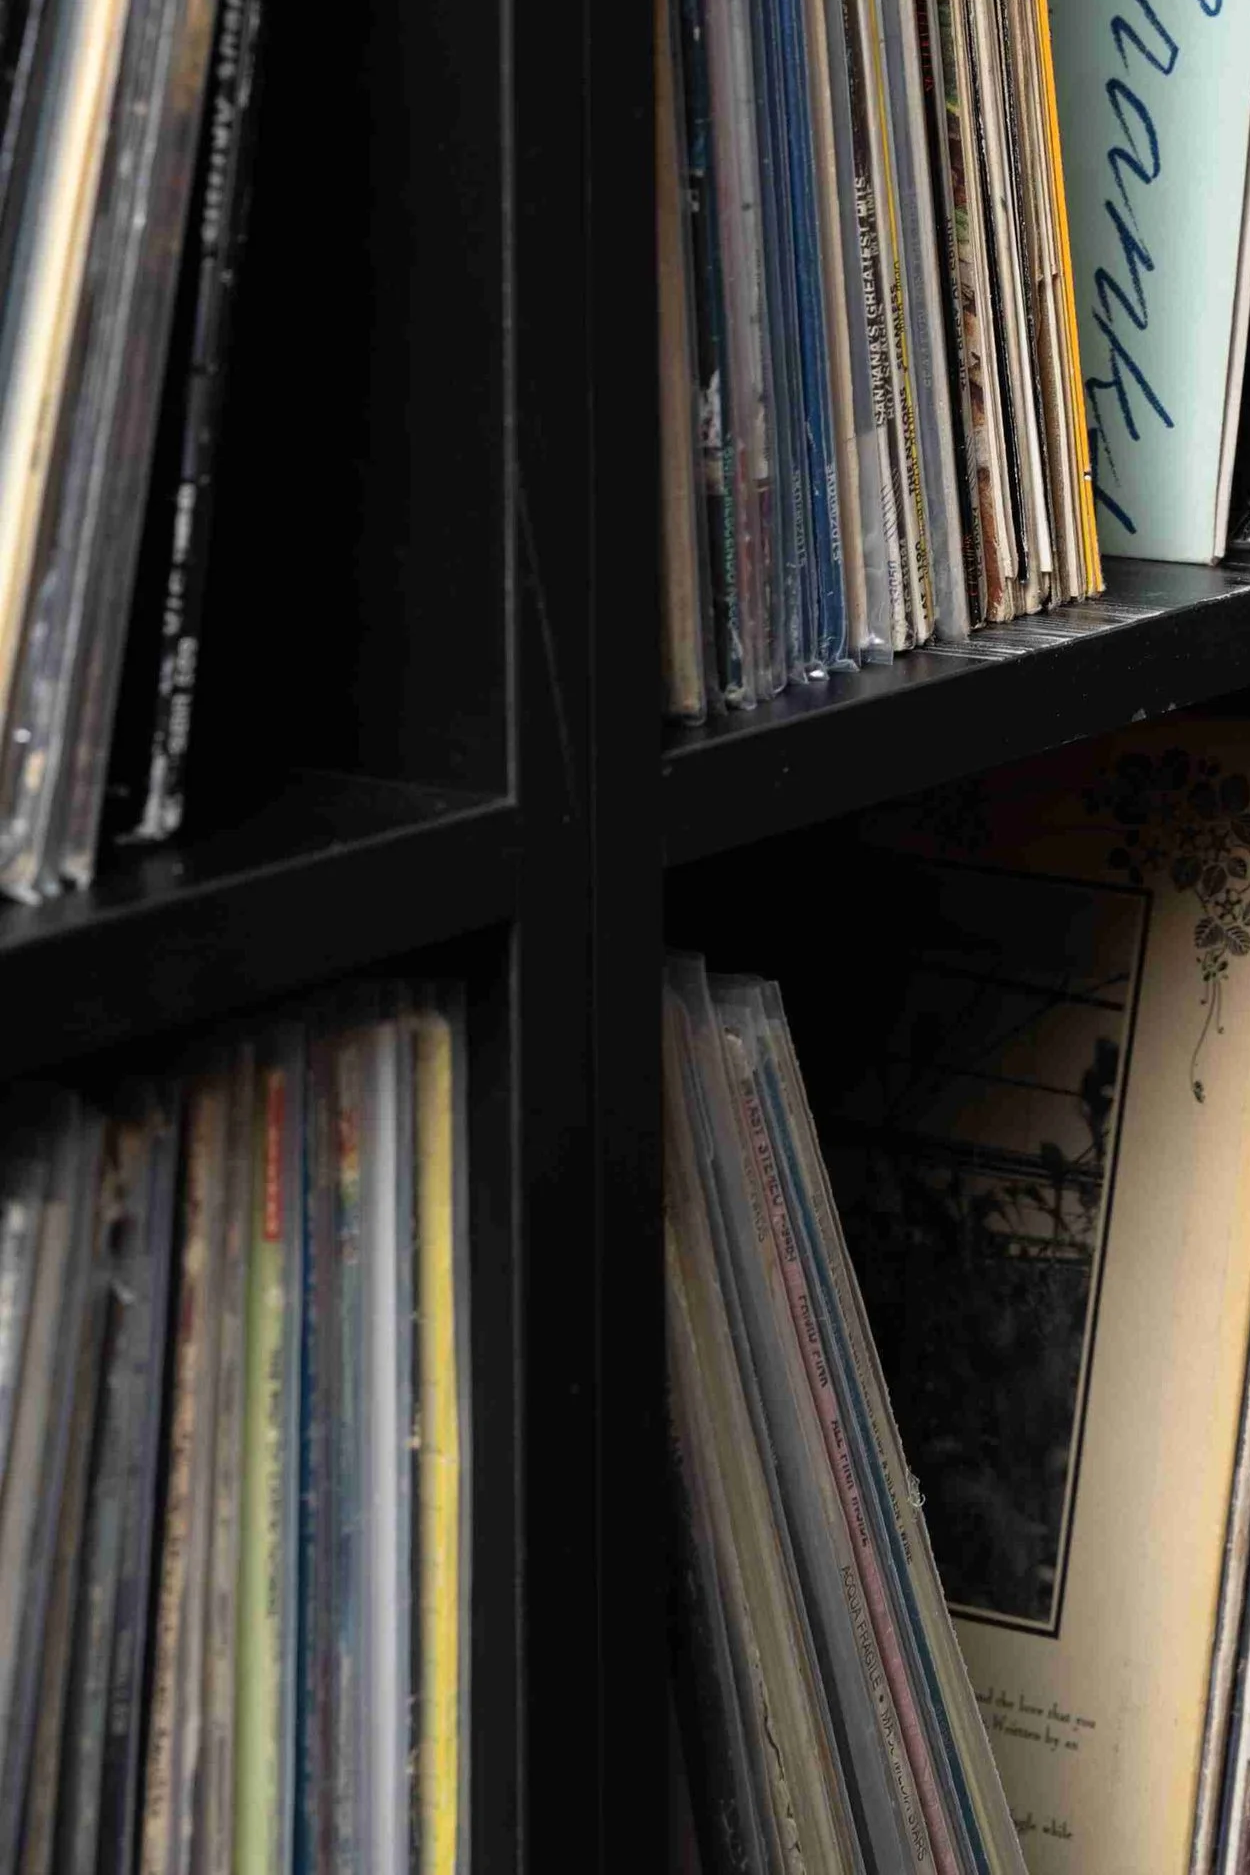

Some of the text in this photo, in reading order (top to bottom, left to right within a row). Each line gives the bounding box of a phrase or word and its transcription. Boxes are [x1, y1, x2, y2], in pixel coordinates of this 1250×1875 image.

[852, 175, 887, 425] SANTANA'S GREATEST HITS
[888, 283, 905, 370] SEAMLESS
[898, 386, 913, 460] NYLONS
[905, 461, 916, 495] THE
[837, 1564, 866, 1621] ACQUA
[853, 1621, 886, 1692] FRAGILE
[904, 1812, 929, 1862] STARS
[1045, 1724, 1059, 1752] by
